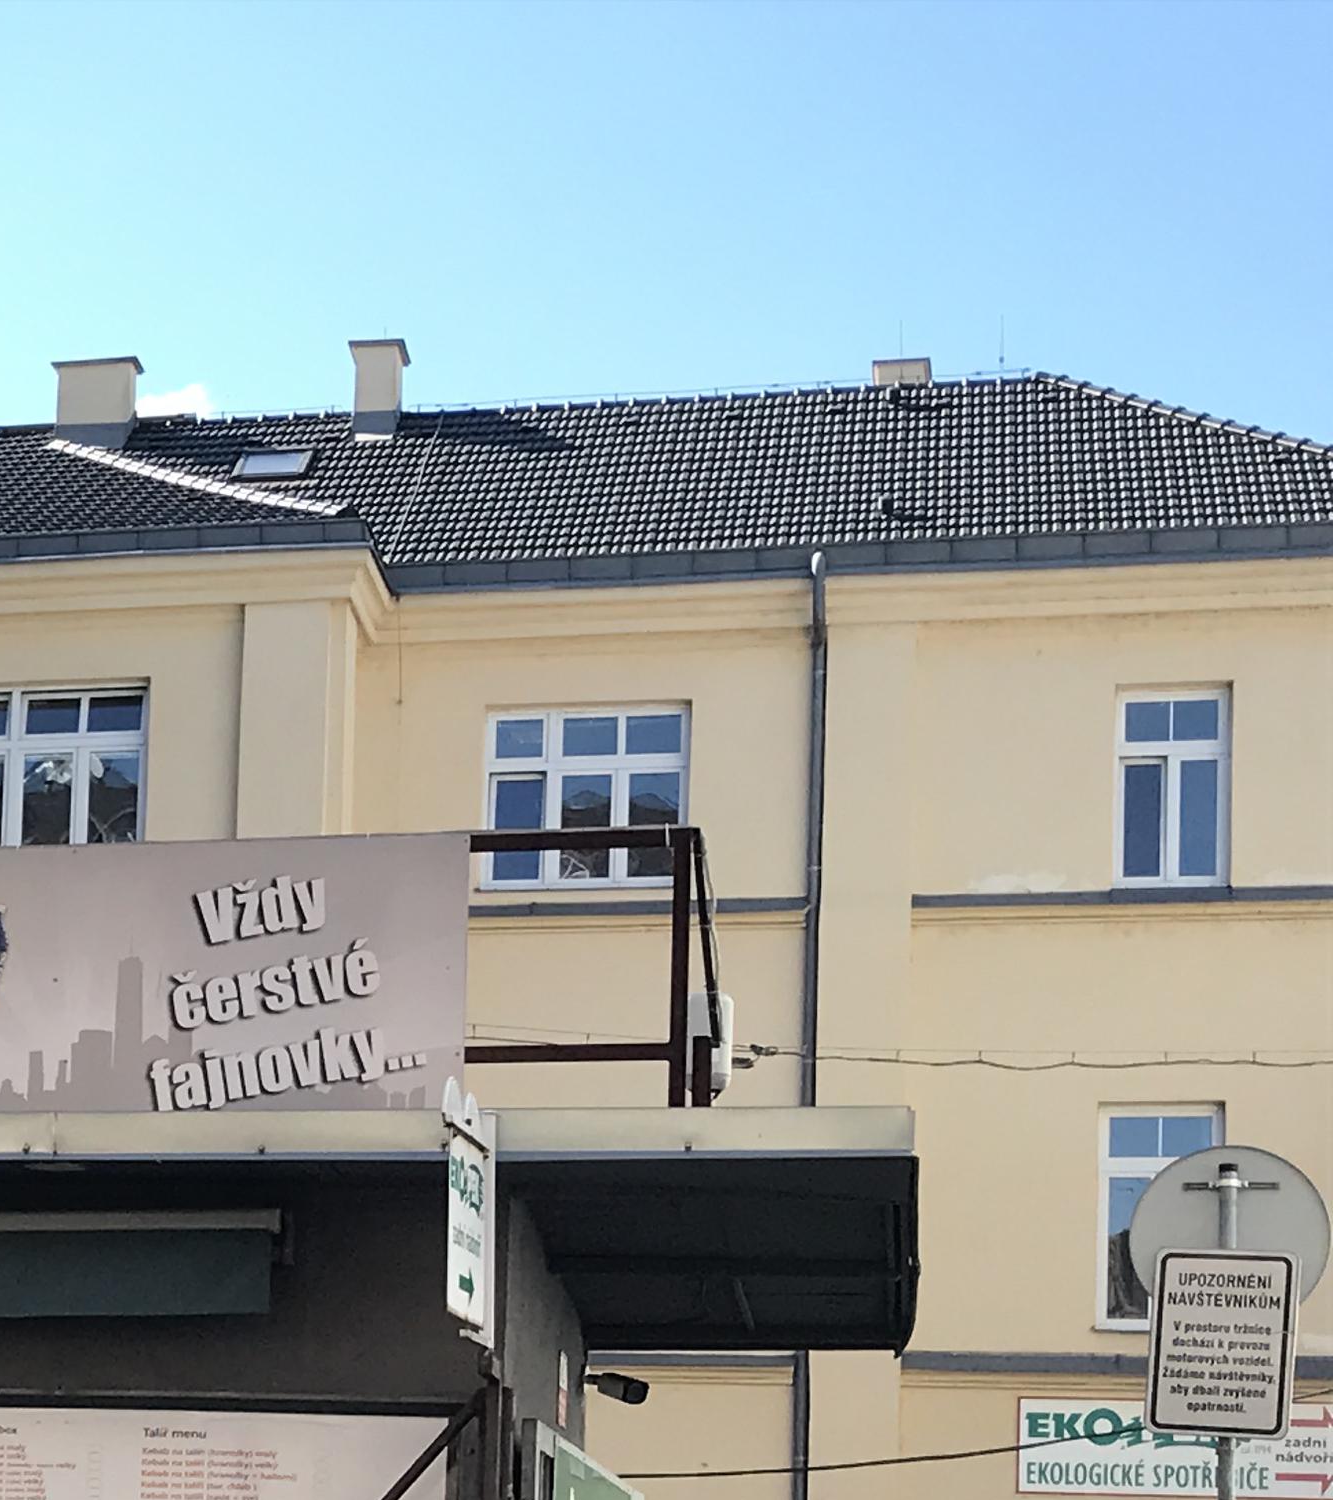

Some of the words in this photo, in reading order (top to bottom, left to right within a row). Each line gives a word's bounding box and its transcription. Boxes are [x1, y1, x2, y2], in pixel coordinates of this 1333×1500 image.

[193, 873, 326, 946] Vždy
[169, 937, 381, 1030] čerstvé
[1179, 1273, 1272, 1289] UPOZORNĚNÍ
[1174, 1321, 1181, 1331] V
[1218, 1339, 1224, 1348] k
[1170, 1384, 1189, 1396] aby
[172, 1429, 206, 1439] menu
[1284, 1437, 1326, 1448] zadní
[1026, 1459, 1144, 1487] EKOLOGICKÉ
[1152, 1461, 1269, 1490] SPOTŘIČE
